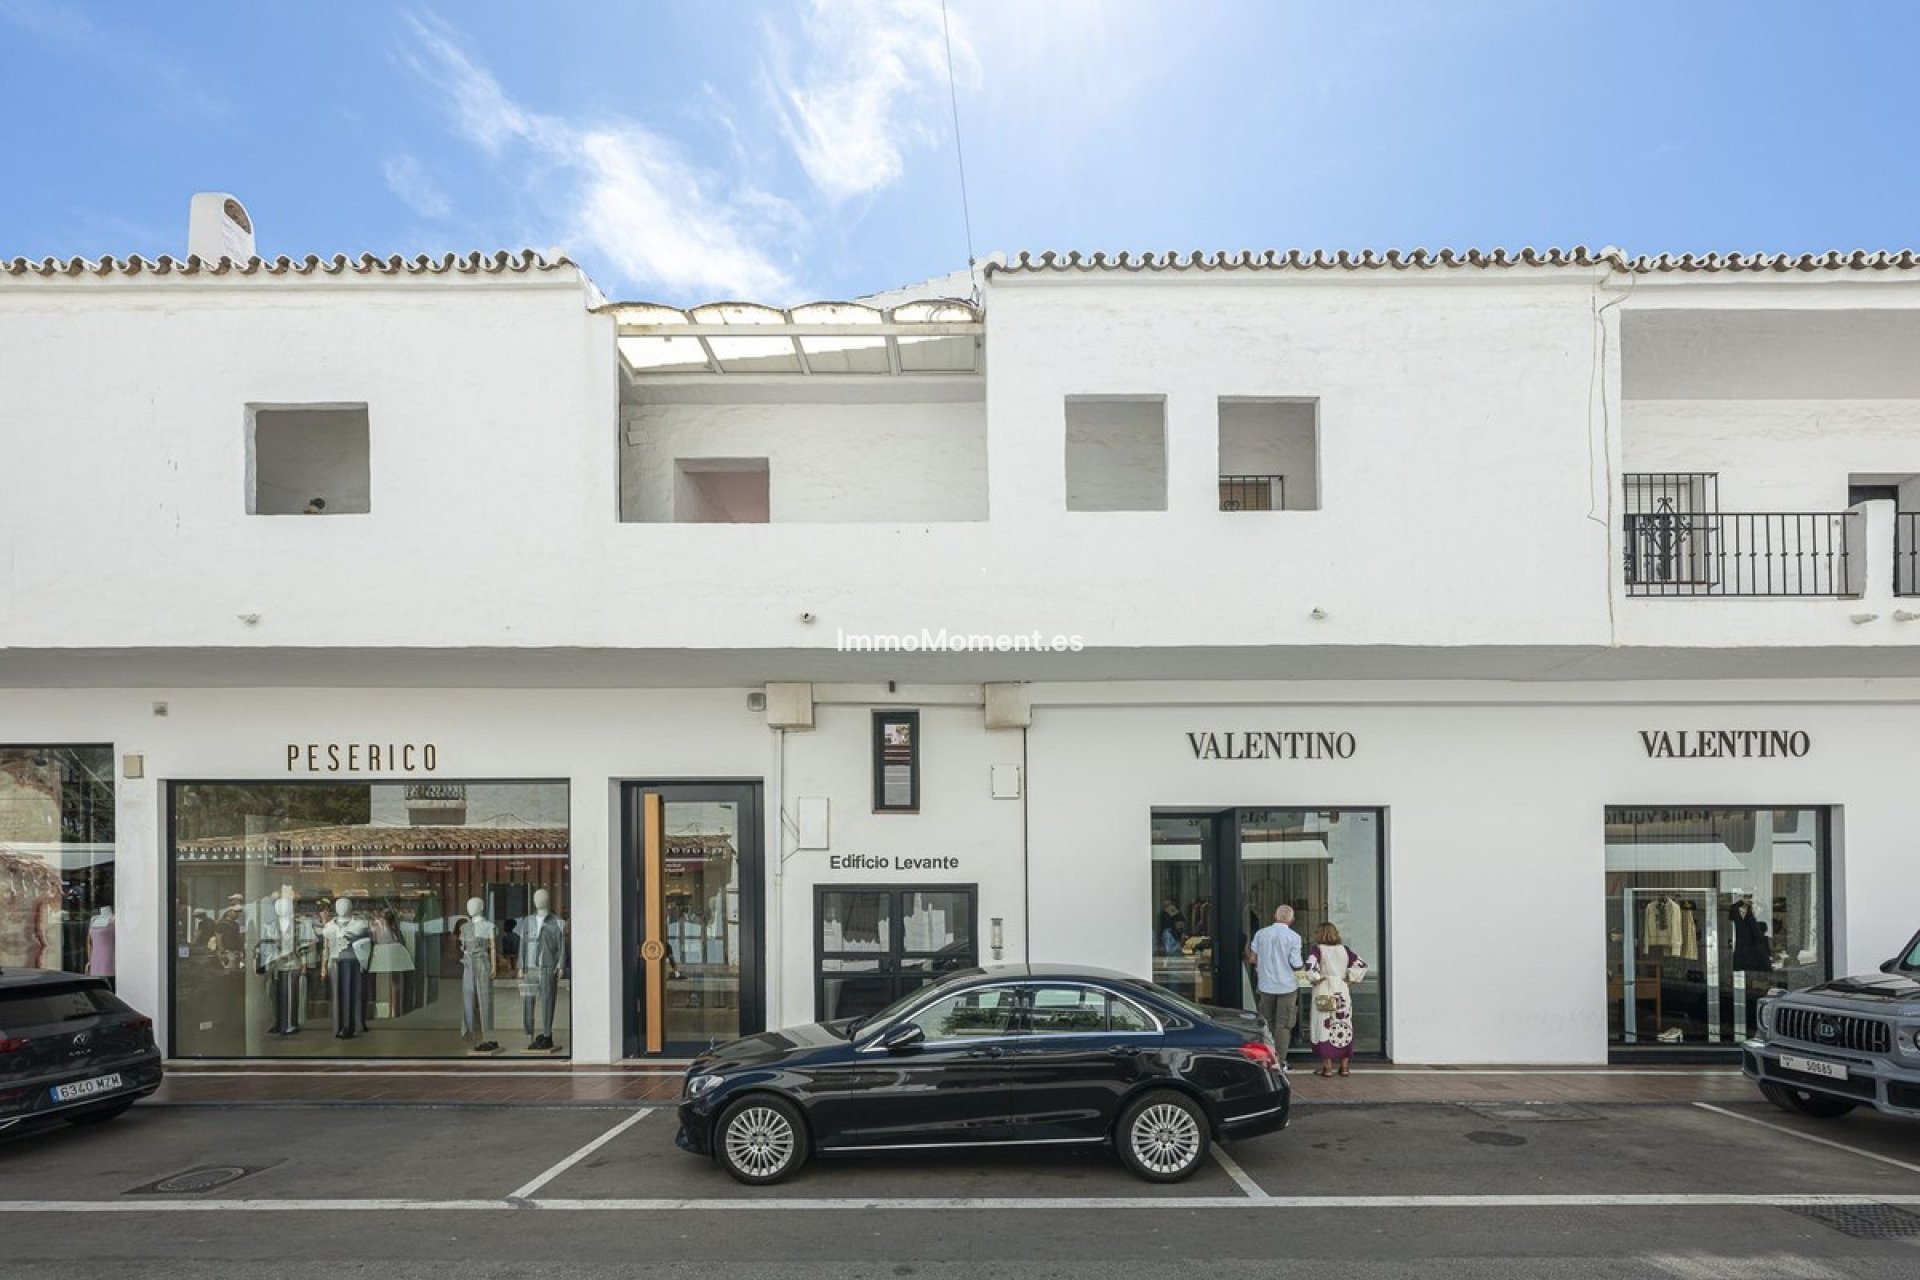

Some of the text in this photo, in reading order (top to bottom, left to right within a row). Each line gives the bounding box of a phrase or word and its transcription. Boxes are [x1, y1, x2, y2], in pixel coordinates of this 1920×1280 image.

[287, 743, 438, 772] PESERICO
[1186, 731, 1357, 760] VALENTINO
[1639, 730, 1811, 758] VALENTINO
[829, 854, 959, 870] Edificio Levante
[60, 1081, 93, 1098] 6340
